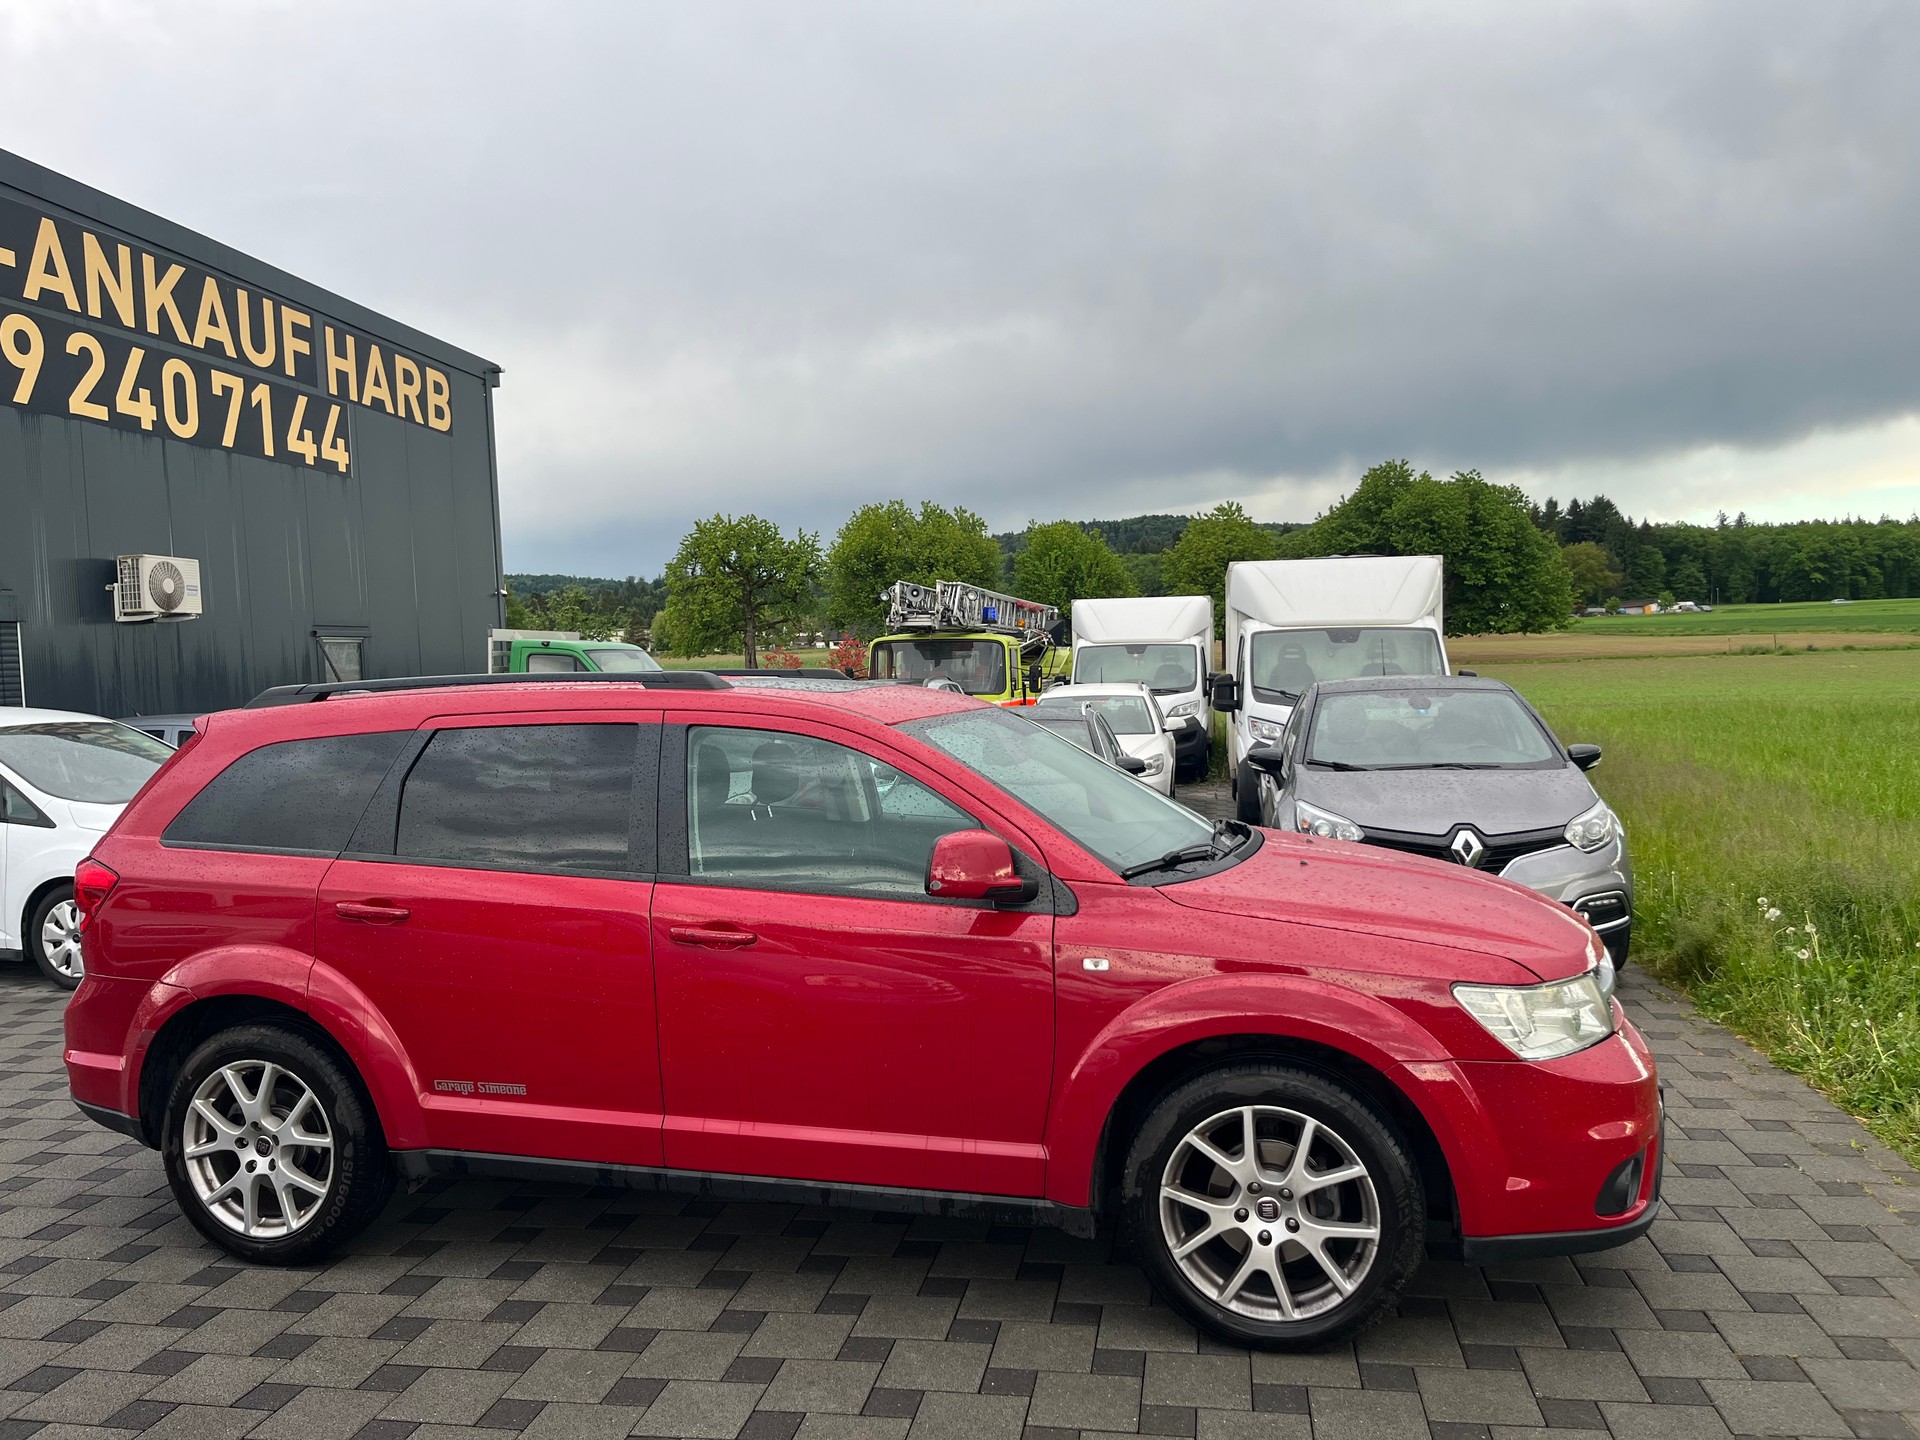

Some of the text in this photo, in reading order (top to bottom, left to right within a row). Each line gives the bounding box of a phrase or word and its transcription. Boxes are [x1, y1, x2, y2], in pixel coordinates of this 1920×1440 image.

[0, 313, 44, 404] 9
[325, 327, 451, 431] HARB
[434, 1080, 527, 1095] Garage Simeone
